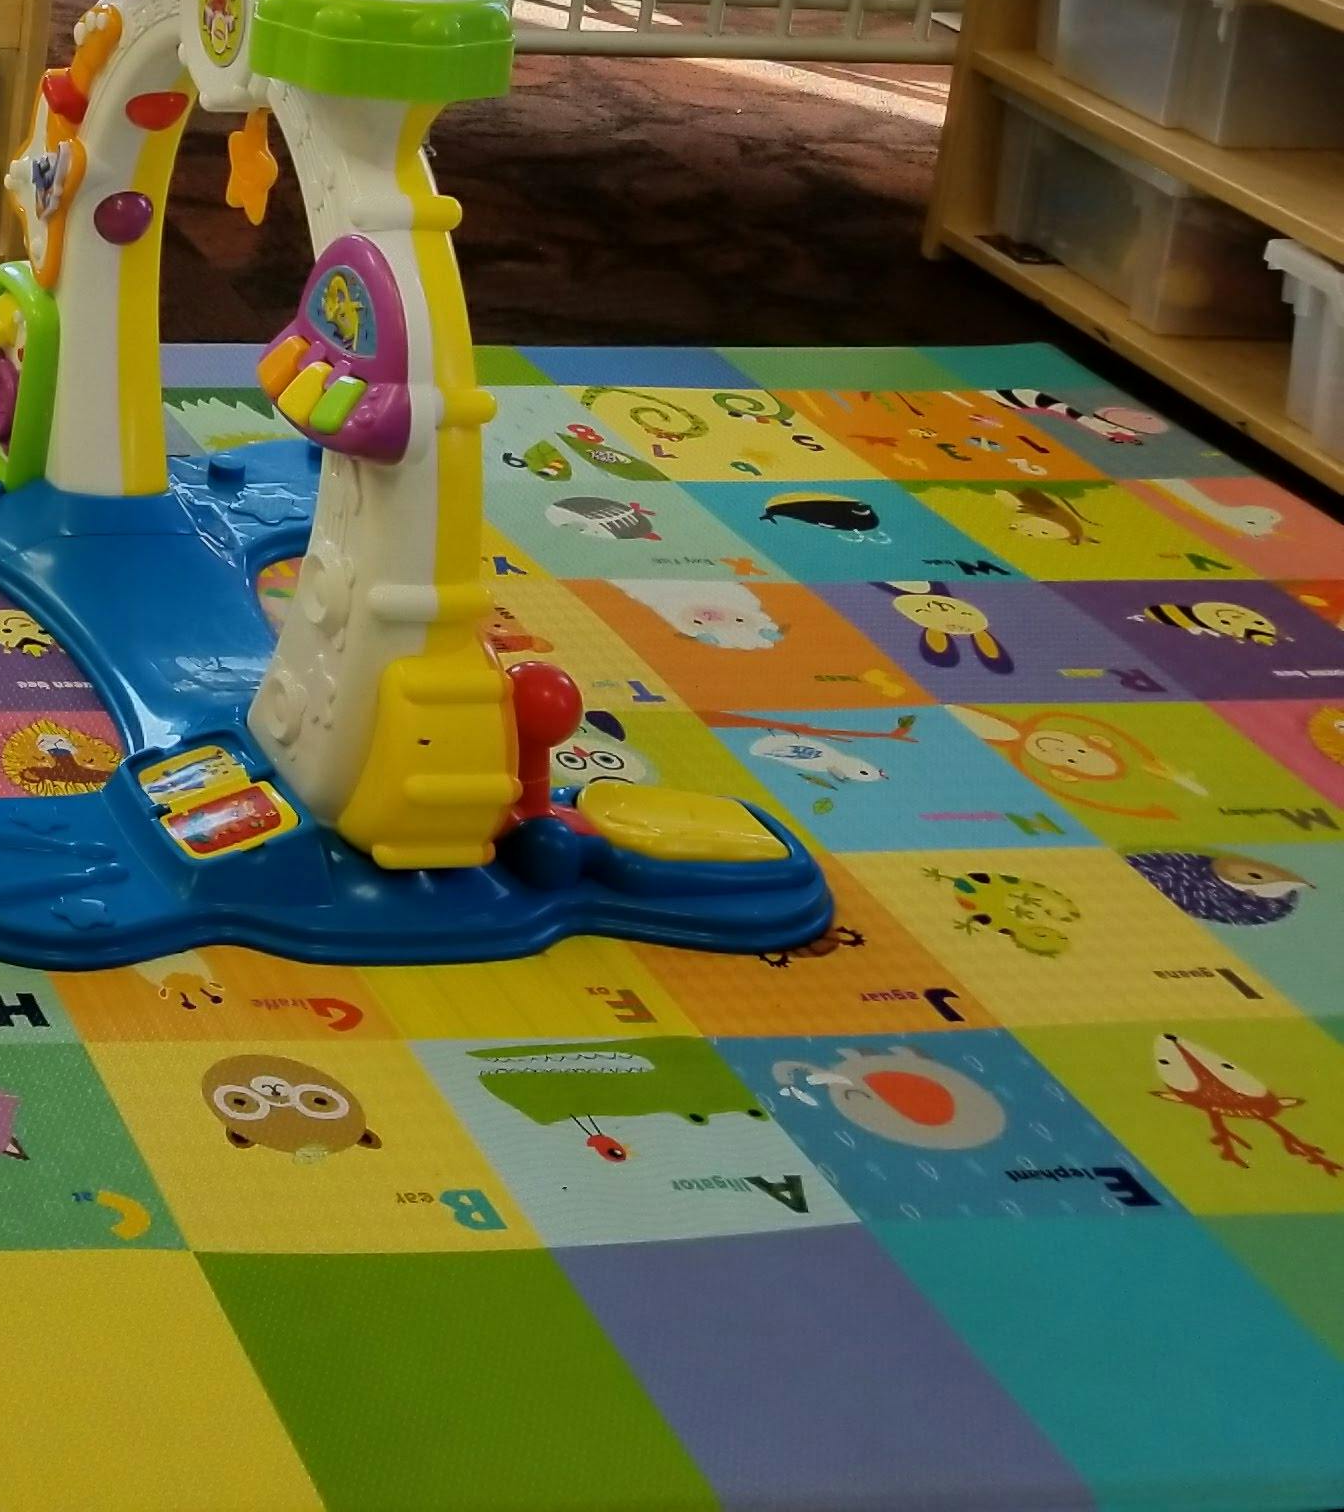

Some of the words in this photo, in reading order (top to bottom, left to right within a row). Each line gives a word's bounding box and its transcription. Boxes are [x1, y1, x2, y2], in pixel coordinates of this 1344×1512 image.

[566, 424, 605, 444] 8
[1152, 967, 1265, 999] Iguana
[859, 988, 966, 1022] Jaguar
[671, 1174, 810, 1214] Alligator
[1004, 1165, 1162, 1207] Elephant
[396, 1189, 509, 1230] Bear
